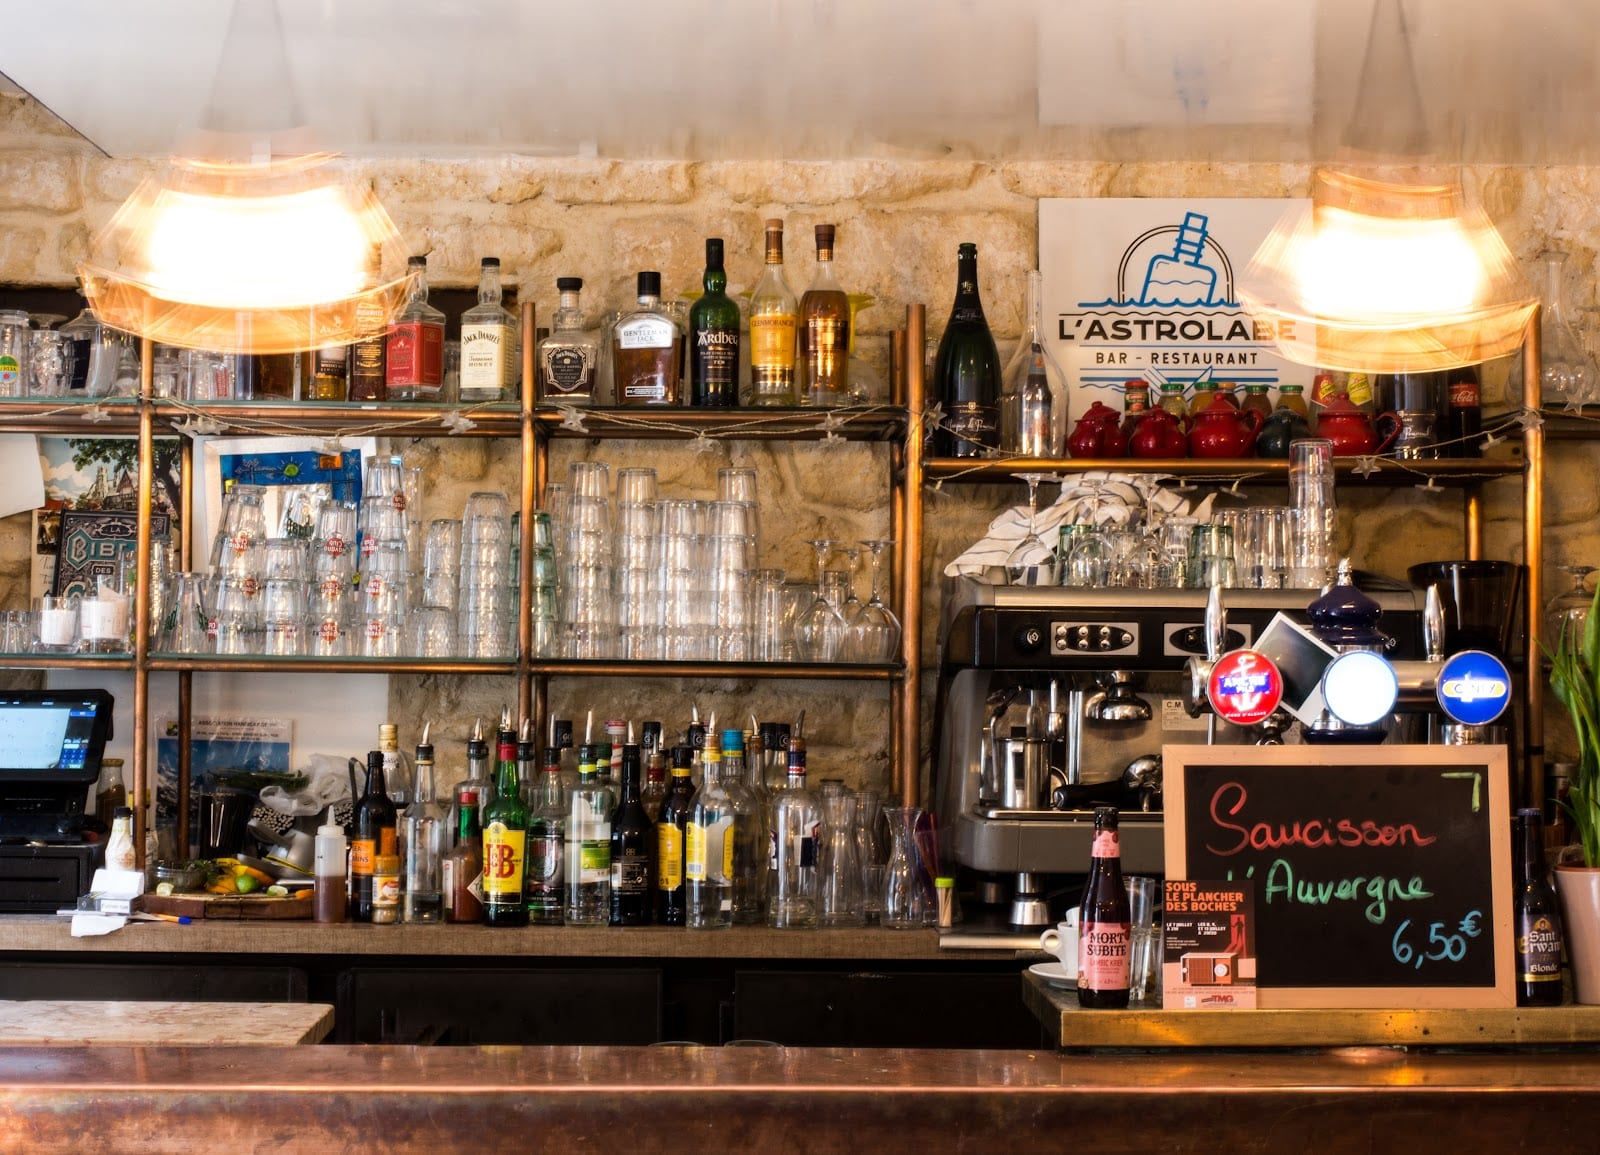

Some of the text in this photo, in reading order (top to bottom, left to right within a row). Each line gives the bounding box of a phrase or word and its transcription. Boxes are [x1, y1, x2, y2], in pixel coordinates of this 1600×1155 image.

[624, 329, 668, 337] GENTLEMAN
[1096, 352, 1128, 365] BAR
[1151, 352, 1258, 365] RESTAURANT
[1206, 781, 1437, 857] Saucisson
[1165, 882, 1197, 892] SOUS
[1165, 892, 1244, 902] LE PLANCHER
[1166, 902, 1237, 912] DES BOCHES
[1090, 932, 1125, 944] MORT
[1087, 944, 1127, 957] SUBITE
